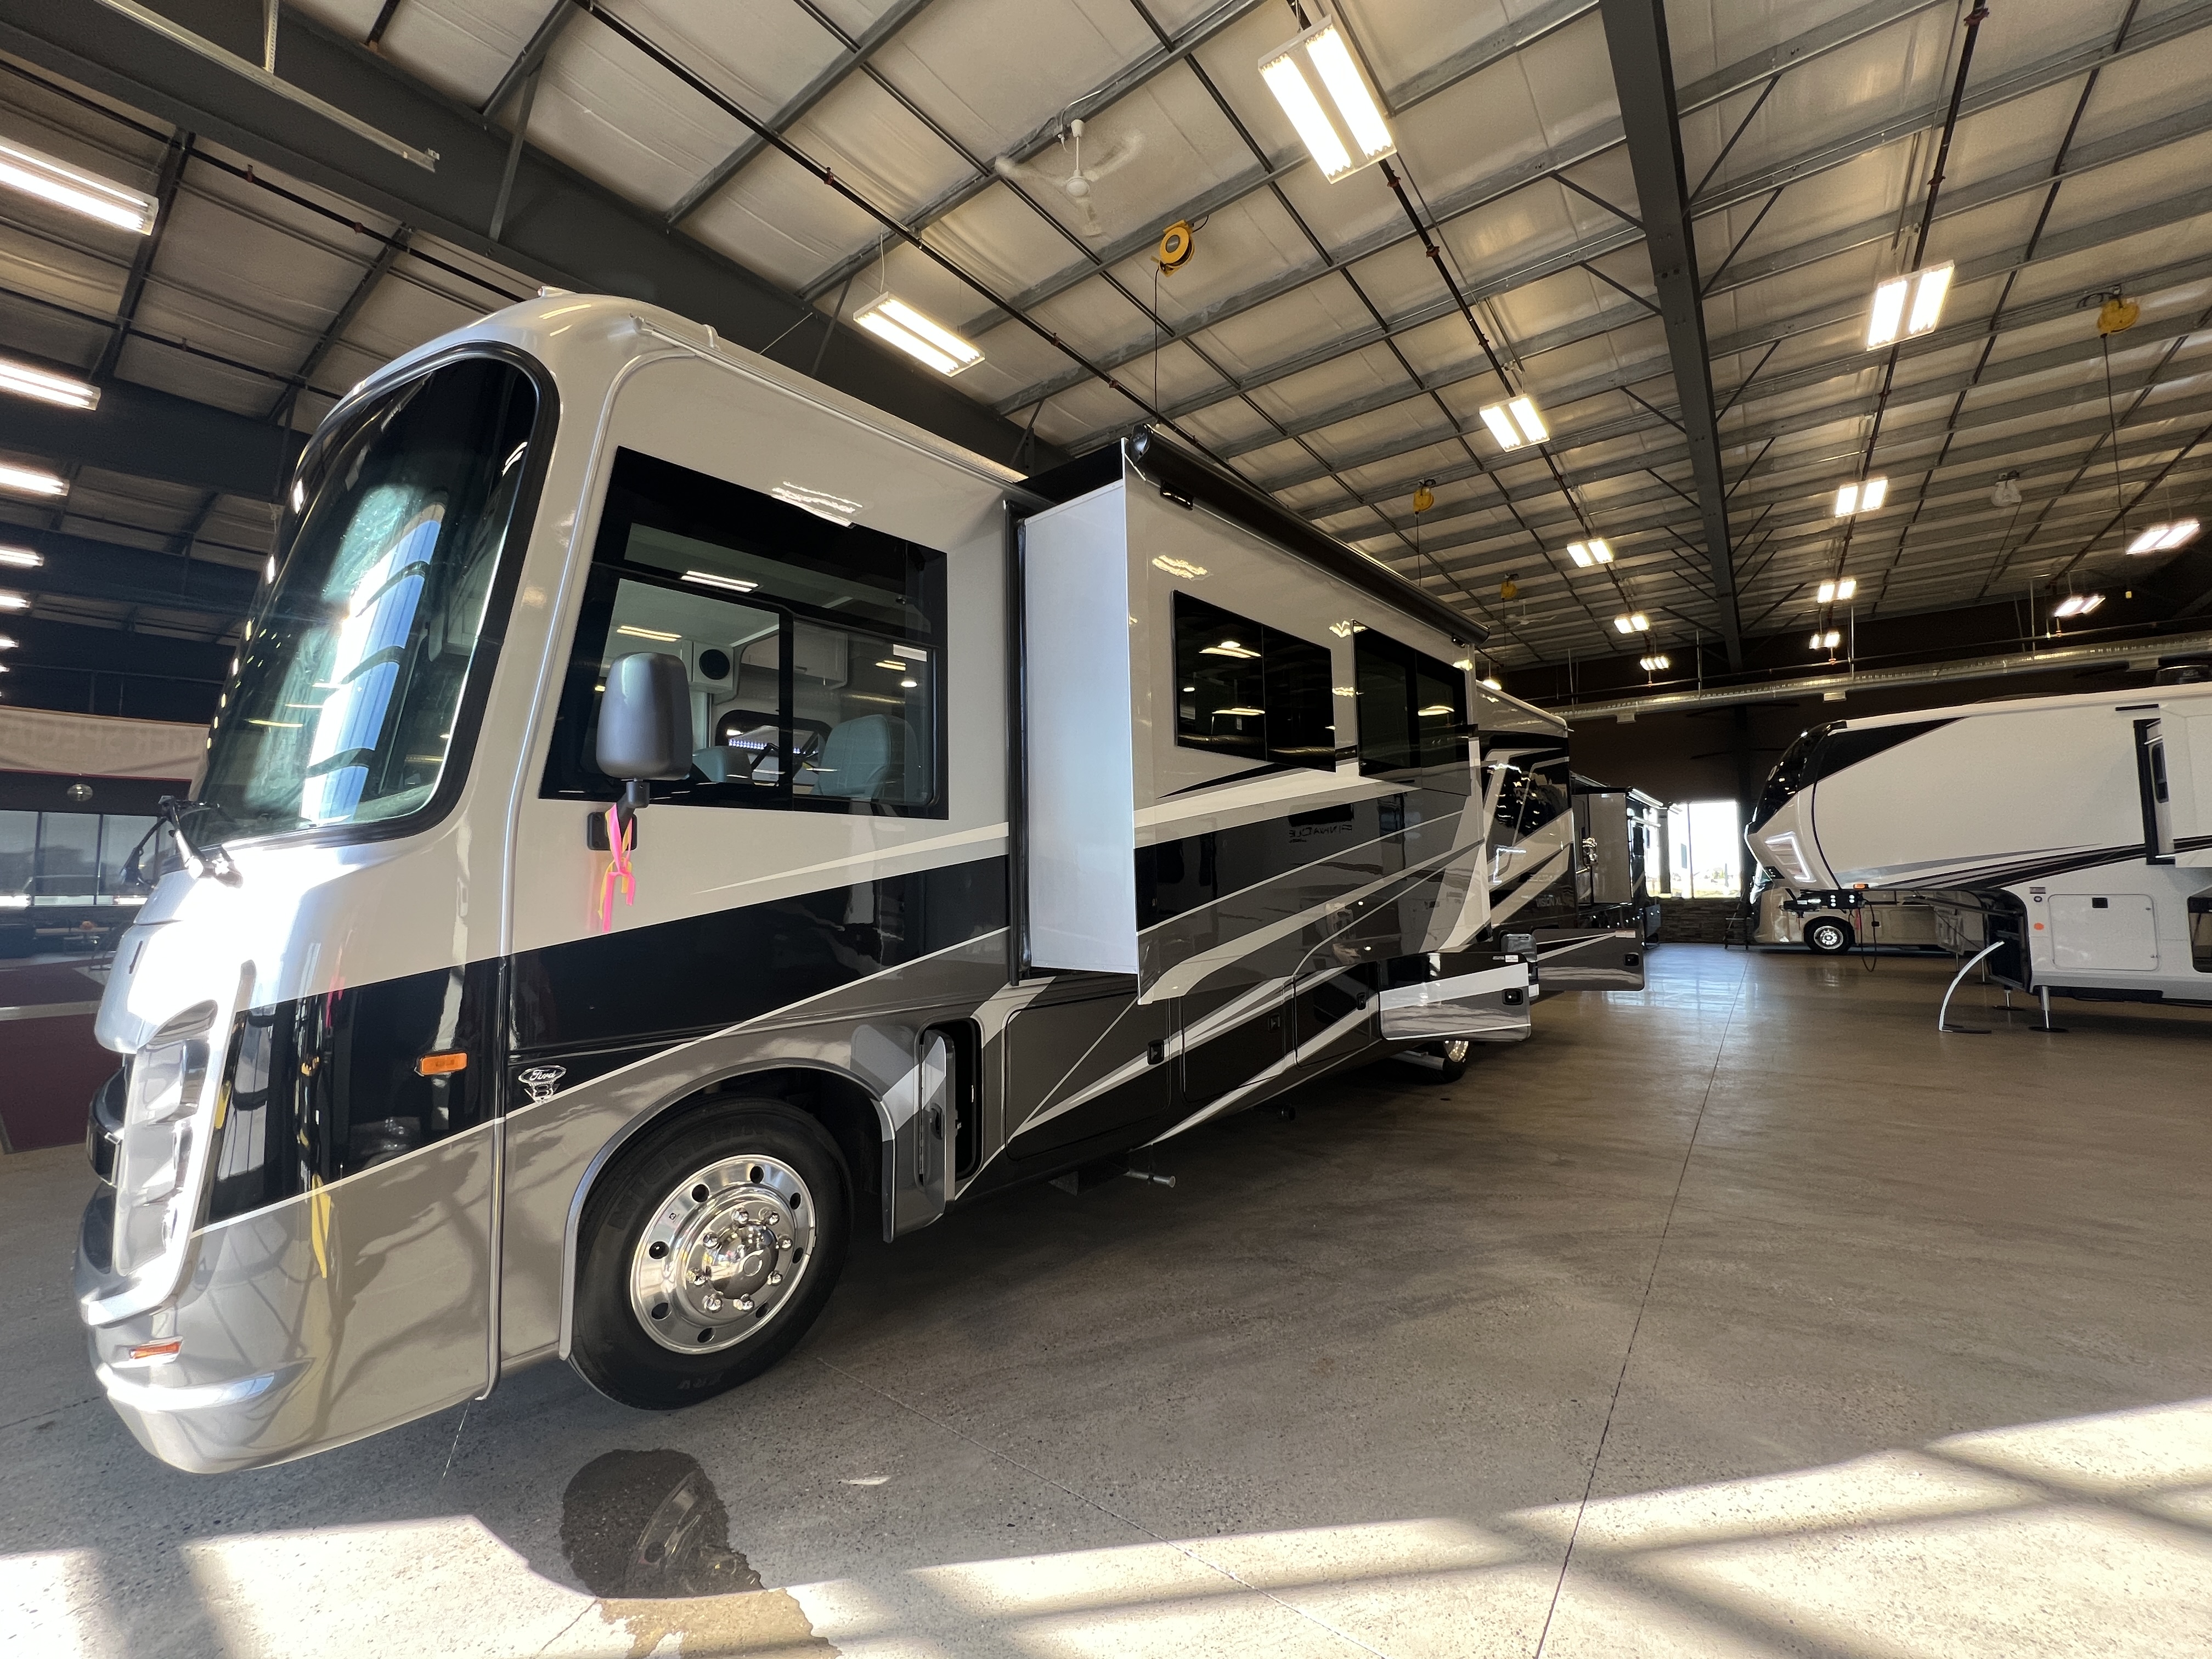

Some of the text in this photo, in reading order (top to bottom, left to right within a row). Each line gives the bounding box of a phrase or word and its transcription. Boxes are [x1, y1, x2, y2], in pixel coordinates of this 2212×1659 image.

[1536, 895, 1555, 907] VISION
[529, 1069, 556, 1081] Ford
[607, 1120, 766, 1231] MICHELIN
